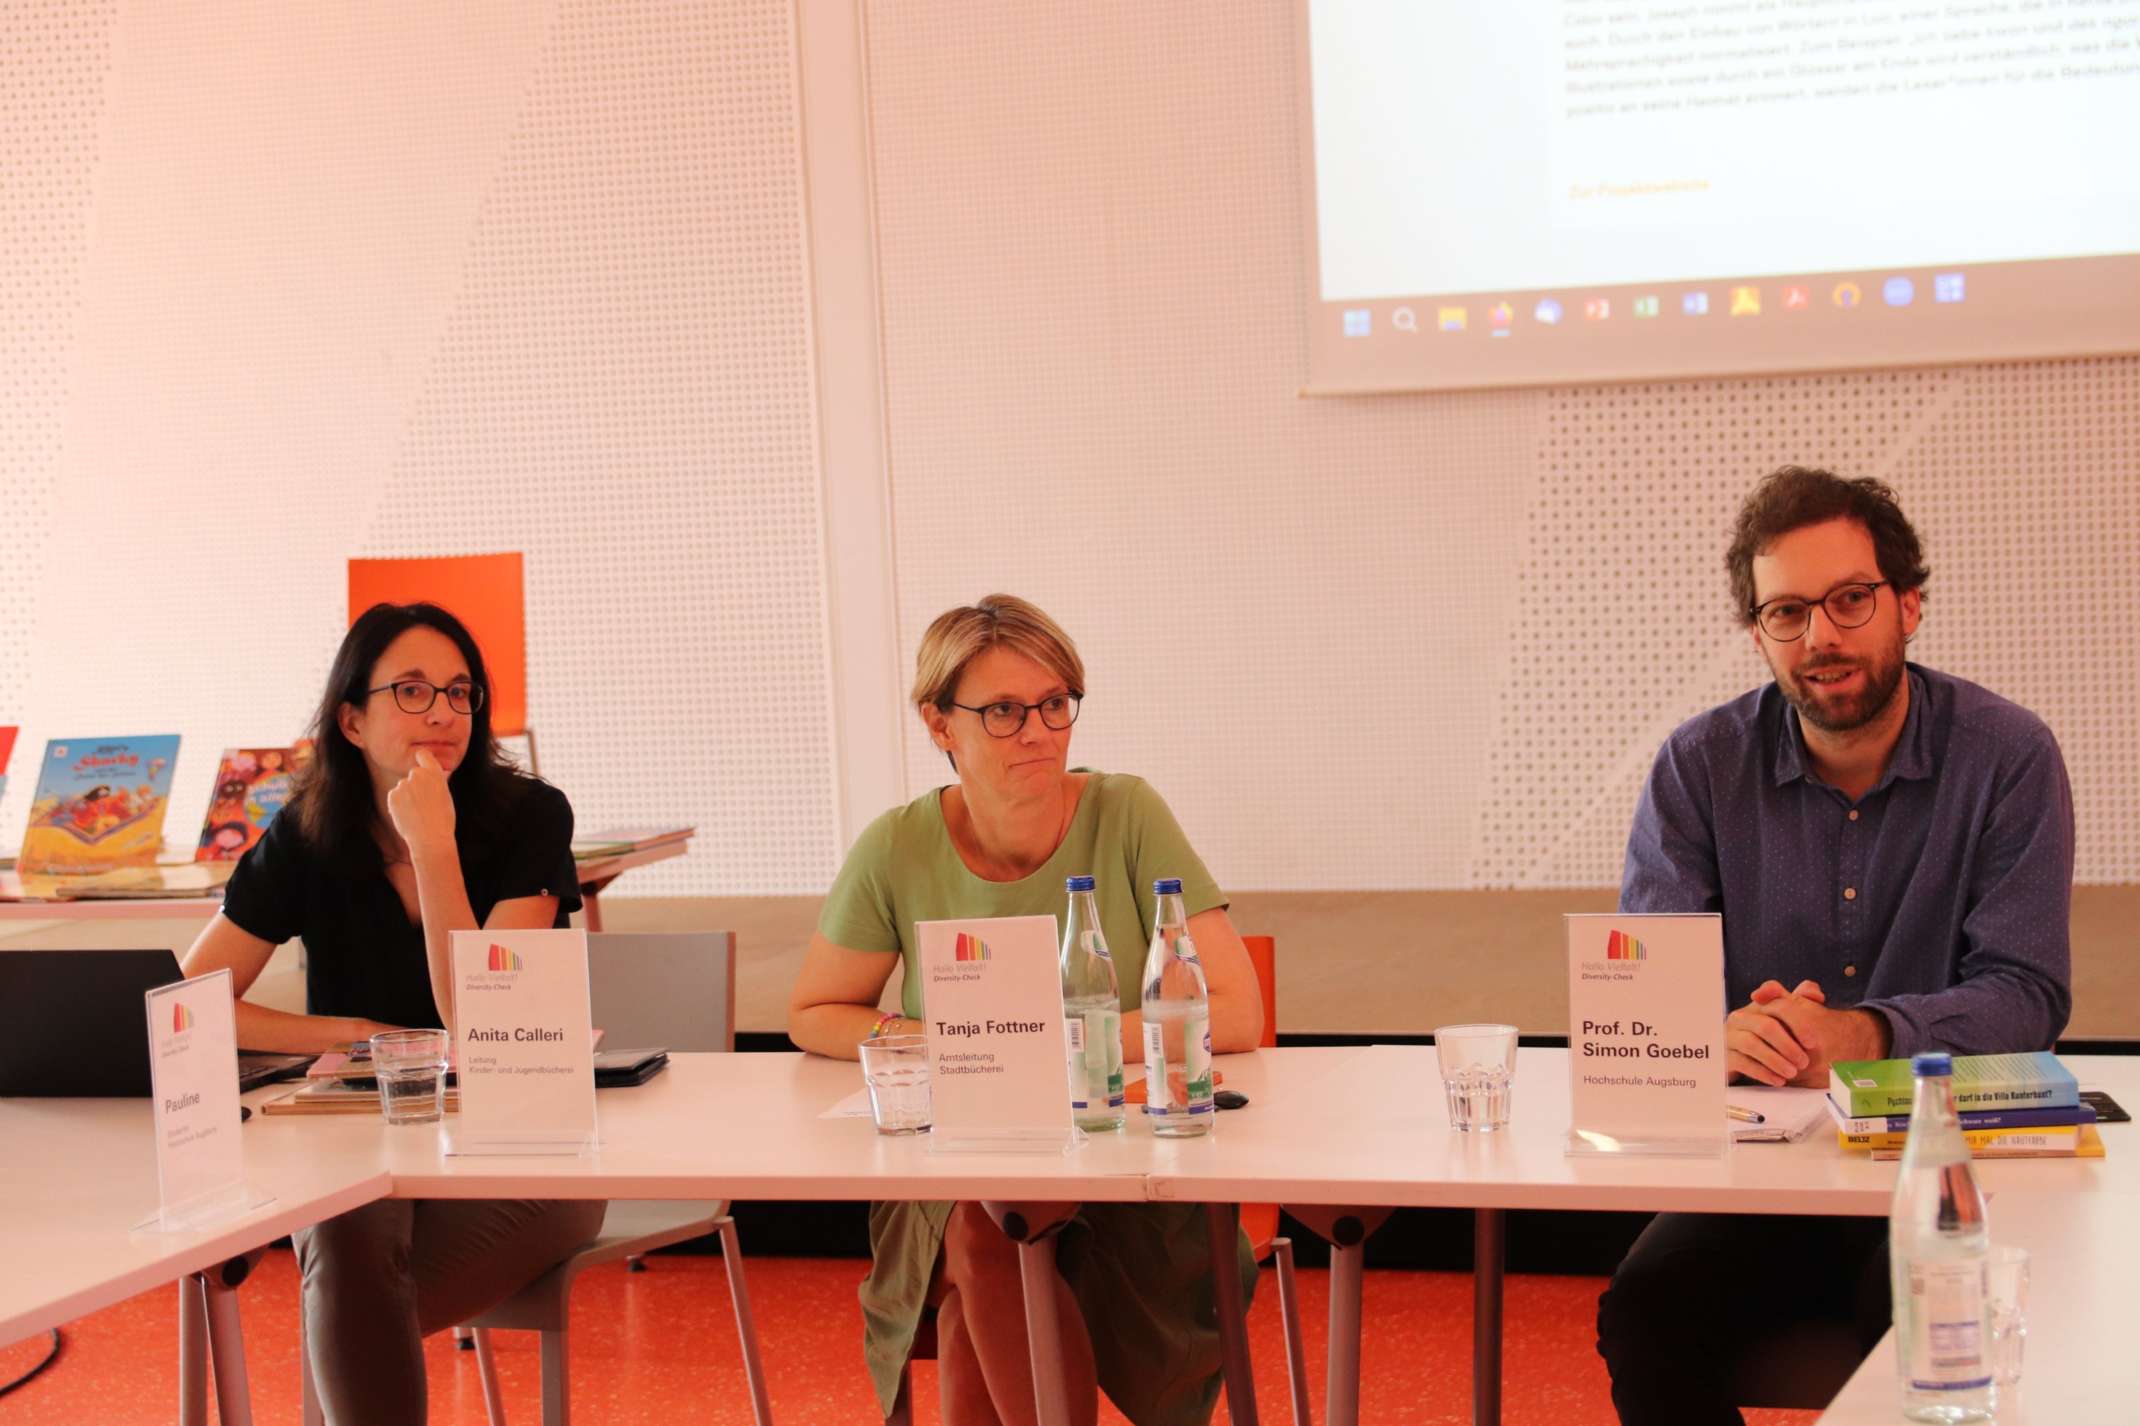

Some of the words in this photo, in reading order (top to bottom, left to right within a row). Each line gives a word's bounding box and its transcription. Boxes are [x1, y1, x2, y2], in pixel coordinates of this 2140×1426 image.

[468, 1027, 509, 1042] Anita
[514, 1027, 564, 1042] Calleri
[936, 1021, 980, 1038] Tanja
[986, 1020, 1045, 1034] Fottner
[1583, 1021, 1625, 1035] Prof.
[1632, 1021, 1658, 1036] Dr.
[939, 1052, 995, 1063] Amtsleitung
[1583, 1042, 1640, 1058] Simon
[1647, 1043, 1709, 1059] Goebel
[468, 1056, 497, 1065] Leitung
[939, 1064, 1004, 1075] Stadtbücherei
[1583, 1075, 1643, 1086] Hochschule
[1646, 1076, 1697, 1089] Augsburg
[165, 1092, 201, 1115] Pauline
[1958, 1092, 1973, 1102] darf
[1982, 1092, 1993, 1101] die
[1994, 1091, 2009, 1101] Villa
